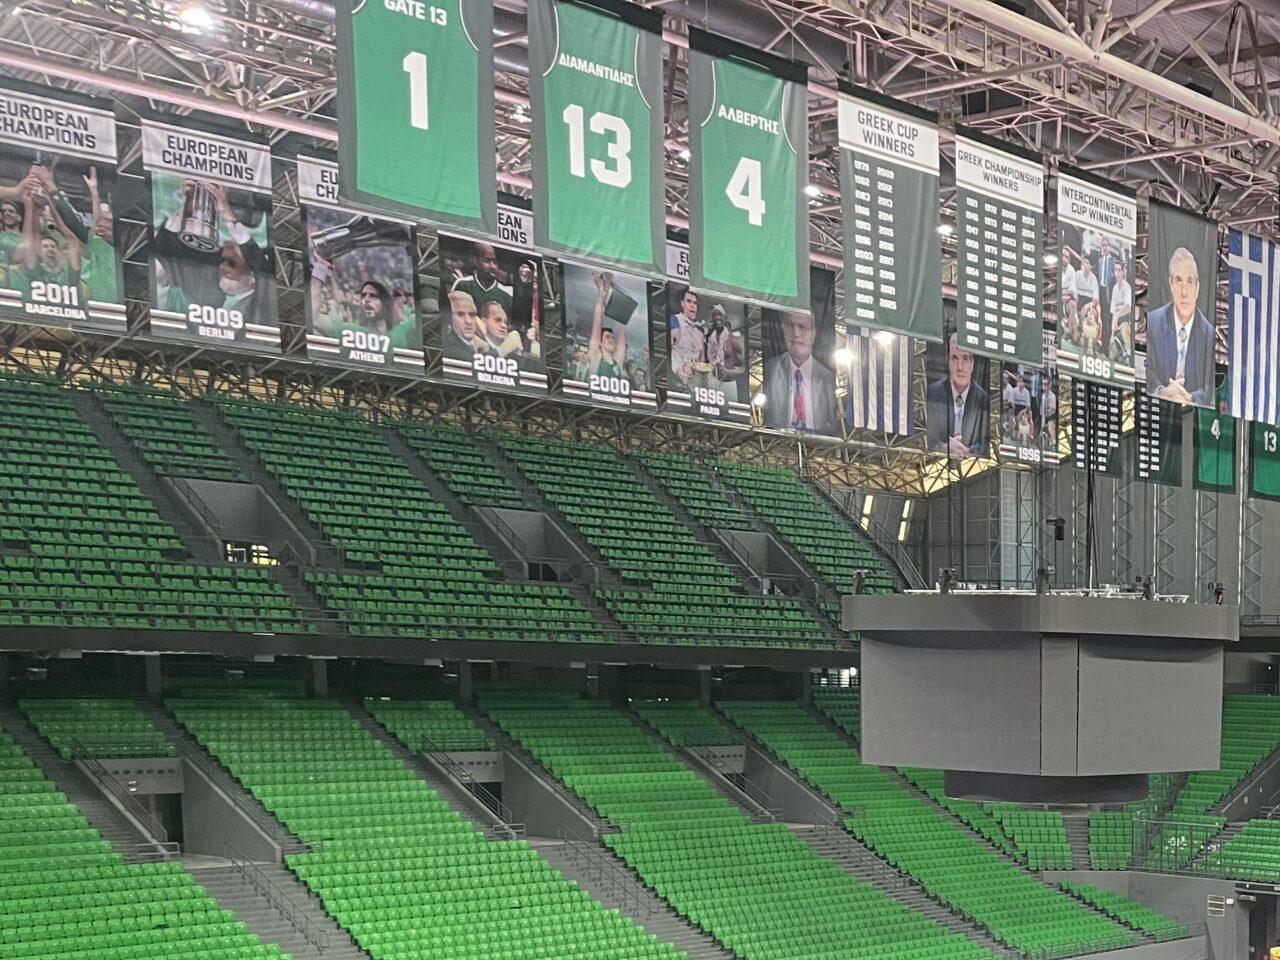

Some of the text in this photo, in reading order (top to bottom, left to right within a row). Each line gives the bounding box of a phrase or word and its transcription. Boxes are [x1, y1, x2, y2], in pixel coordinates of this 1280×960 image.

[384, 0, 447, 26] GATE 13
[558, 52, 634, 87] ΔΙΑΜΑΝΤΙΔΗΣ
[403, 51, 428, 130] 1
[718, 104, 779, 135] ΑΛΒΕΡΤΗΣ
[858, 110, 919, 141] GREEK CUP
[167, 134, 248, 164] EUROPEAN
[562, 103, 632, 188] 13
[862, 128, 915, 158] WINNERS
[162, 150, 254, 181] CHAMPIONS
[958, 149, 1042, 187] GREEK CHAMPIONSHIP
[725, 156, 766, 226] 4
[982, 172, 1019, 192] WINNERS
[1062, 184, 1133, 220] INTERCONTINENTAL
[1071, 202, 1124, 230] CUP WINNERS
[30, 280, 78, 306] 2011
[25, 302, 87, 320] BARCELONA
[188, 304, 243, 329] 2009
[198, 326, 235, 340] BERLIN
[342, 330, 390, 353] 2007
[349, 350, 386, 364] ATHENS
[473, 353, 518, 377] 2002
[1082, 355, 1111, 379] 1996
[478, 372, 516, 387] BOLOGNA
[590, 374, 630, 396] 2000
[694, 386, 726, 406] 1996
[700, 404, 720, 416] PARIS
[1210, 418, 1220, 440] 4
[1264, 430, 1277, 452] 13
[1018, 447, 1041, 462] 1996
